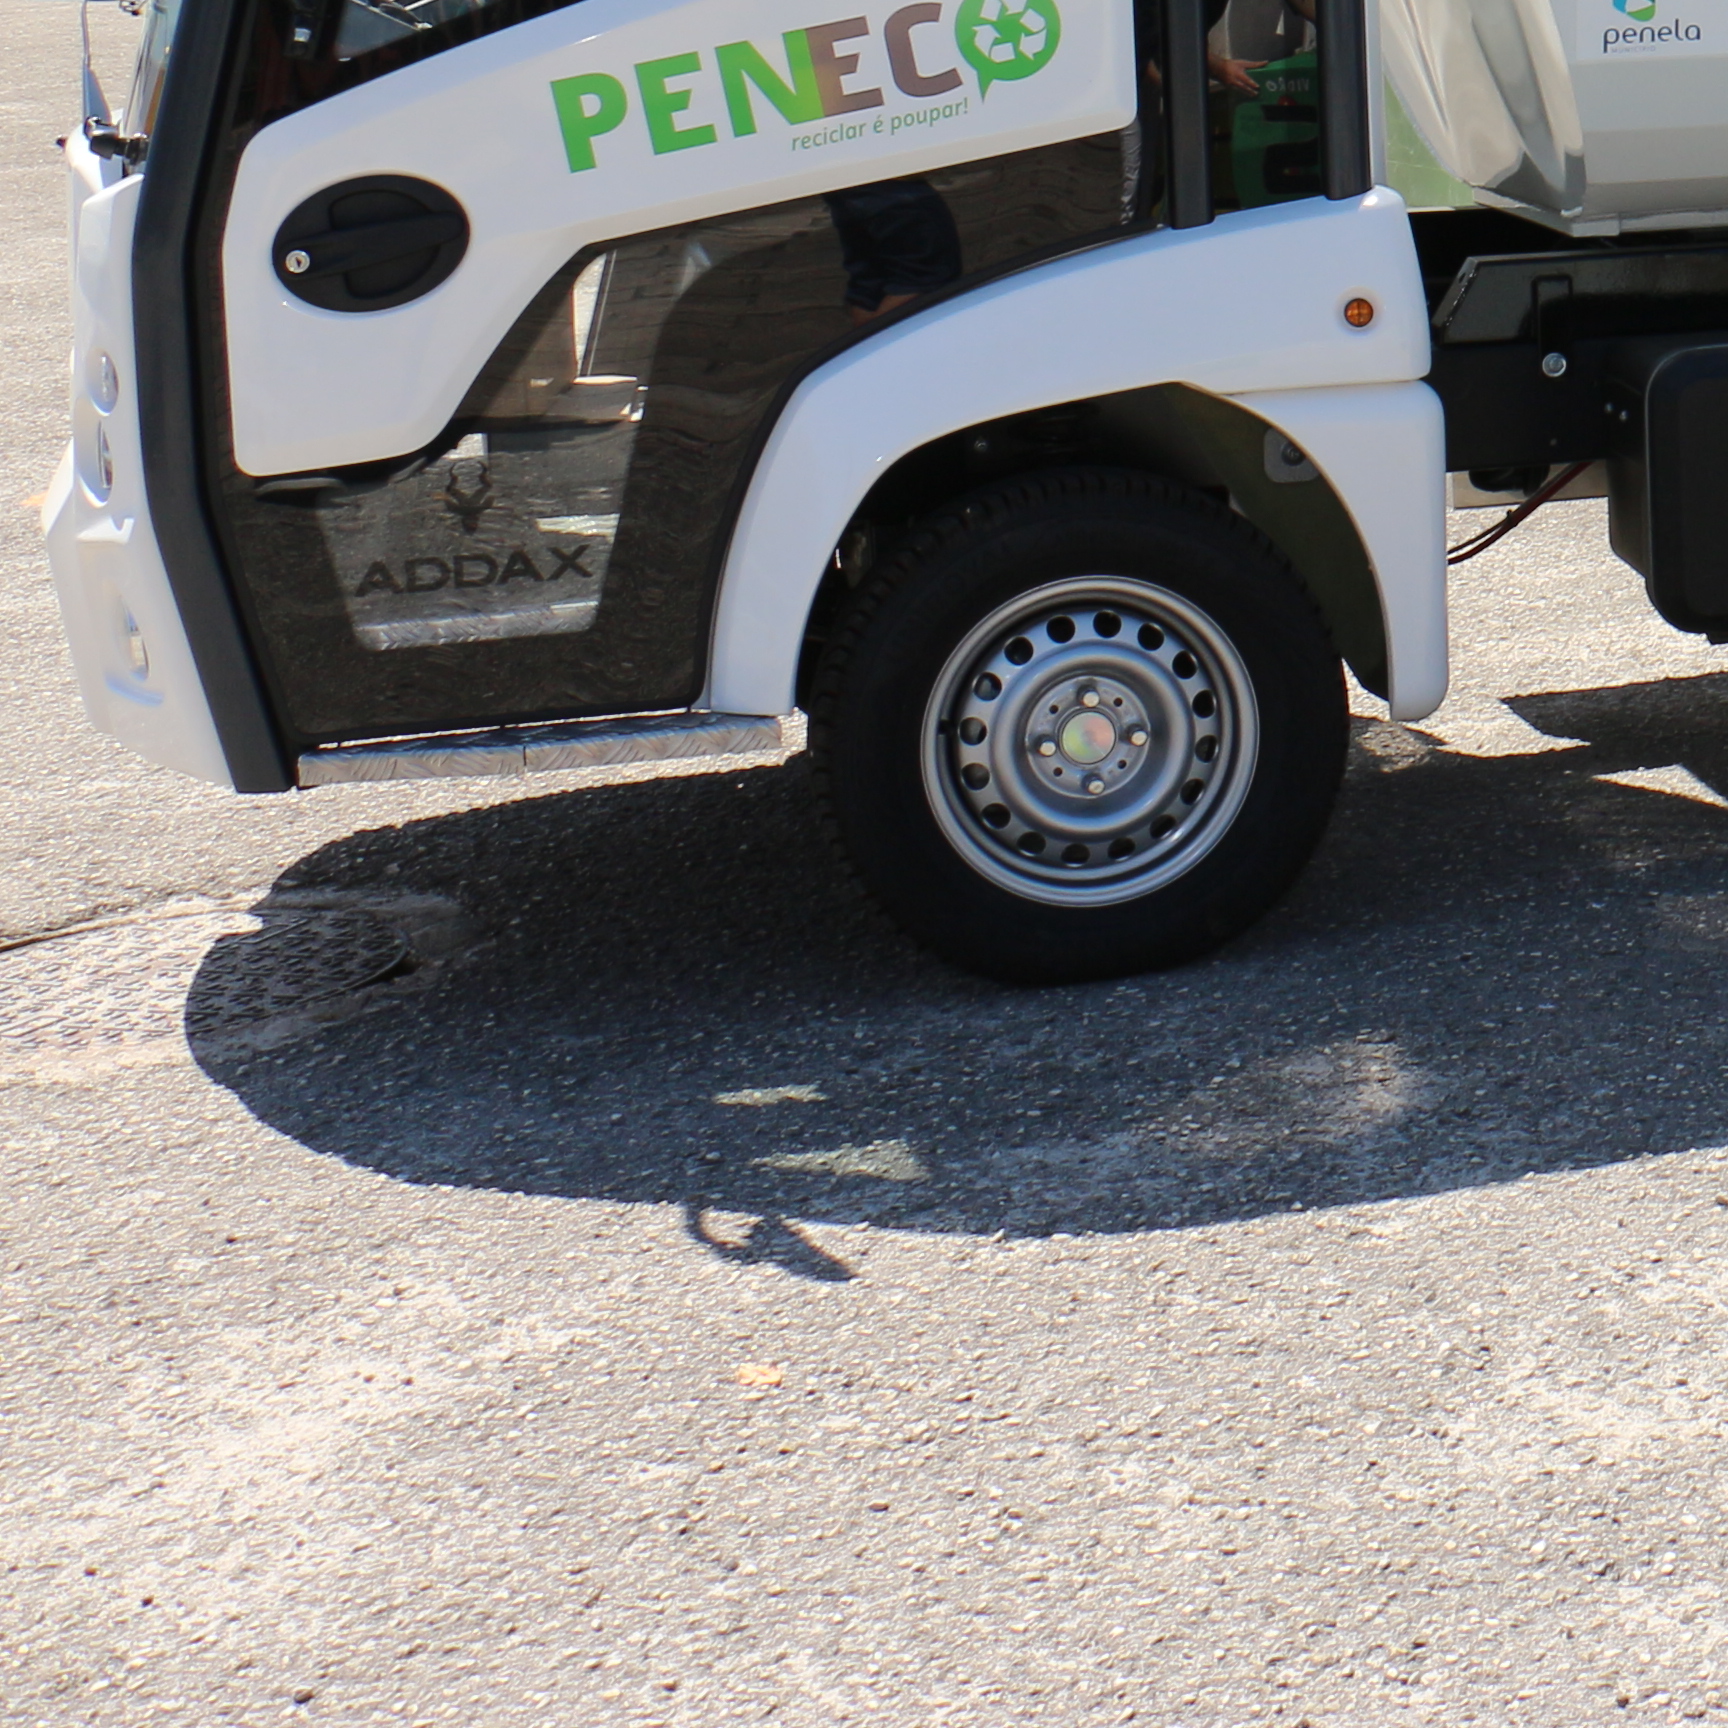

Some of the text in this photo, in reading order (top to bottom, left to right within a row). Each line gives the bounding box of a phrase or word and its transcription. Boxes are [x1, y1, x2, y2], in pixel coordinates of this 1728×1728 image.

[1603, 19, 1701, 54] penela
[790, 97, 969, 151] reciclar é poupar!
[355, 544, 593, 597] ADDAX
